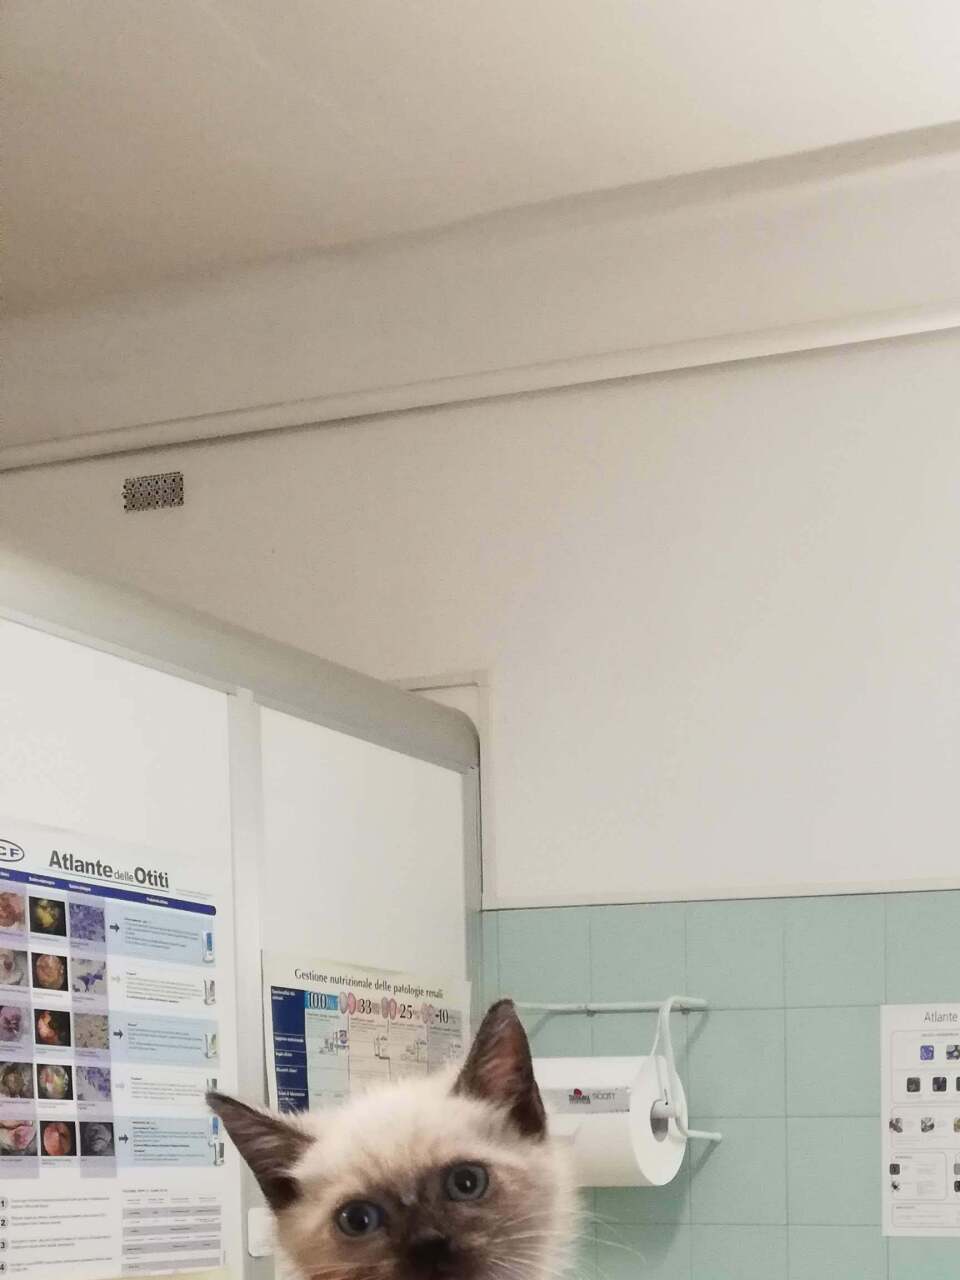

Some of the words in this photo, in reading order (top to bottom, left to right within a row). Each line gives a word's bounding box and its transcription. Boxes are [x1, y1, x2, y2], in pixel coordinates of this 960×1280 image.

[49, 849, 113, 878] Atlante
[114, 869, 134, 882] delle
[134, 866, 169, 889] Otiti
[294, 968, 328, 983] Gestione
[330, 975, 373, 990] nutrizionale
[375, 978, 392, 992] delle
[393, 984, 425, 998] patologie
[924, 1010, 958, 1022] Atlante
